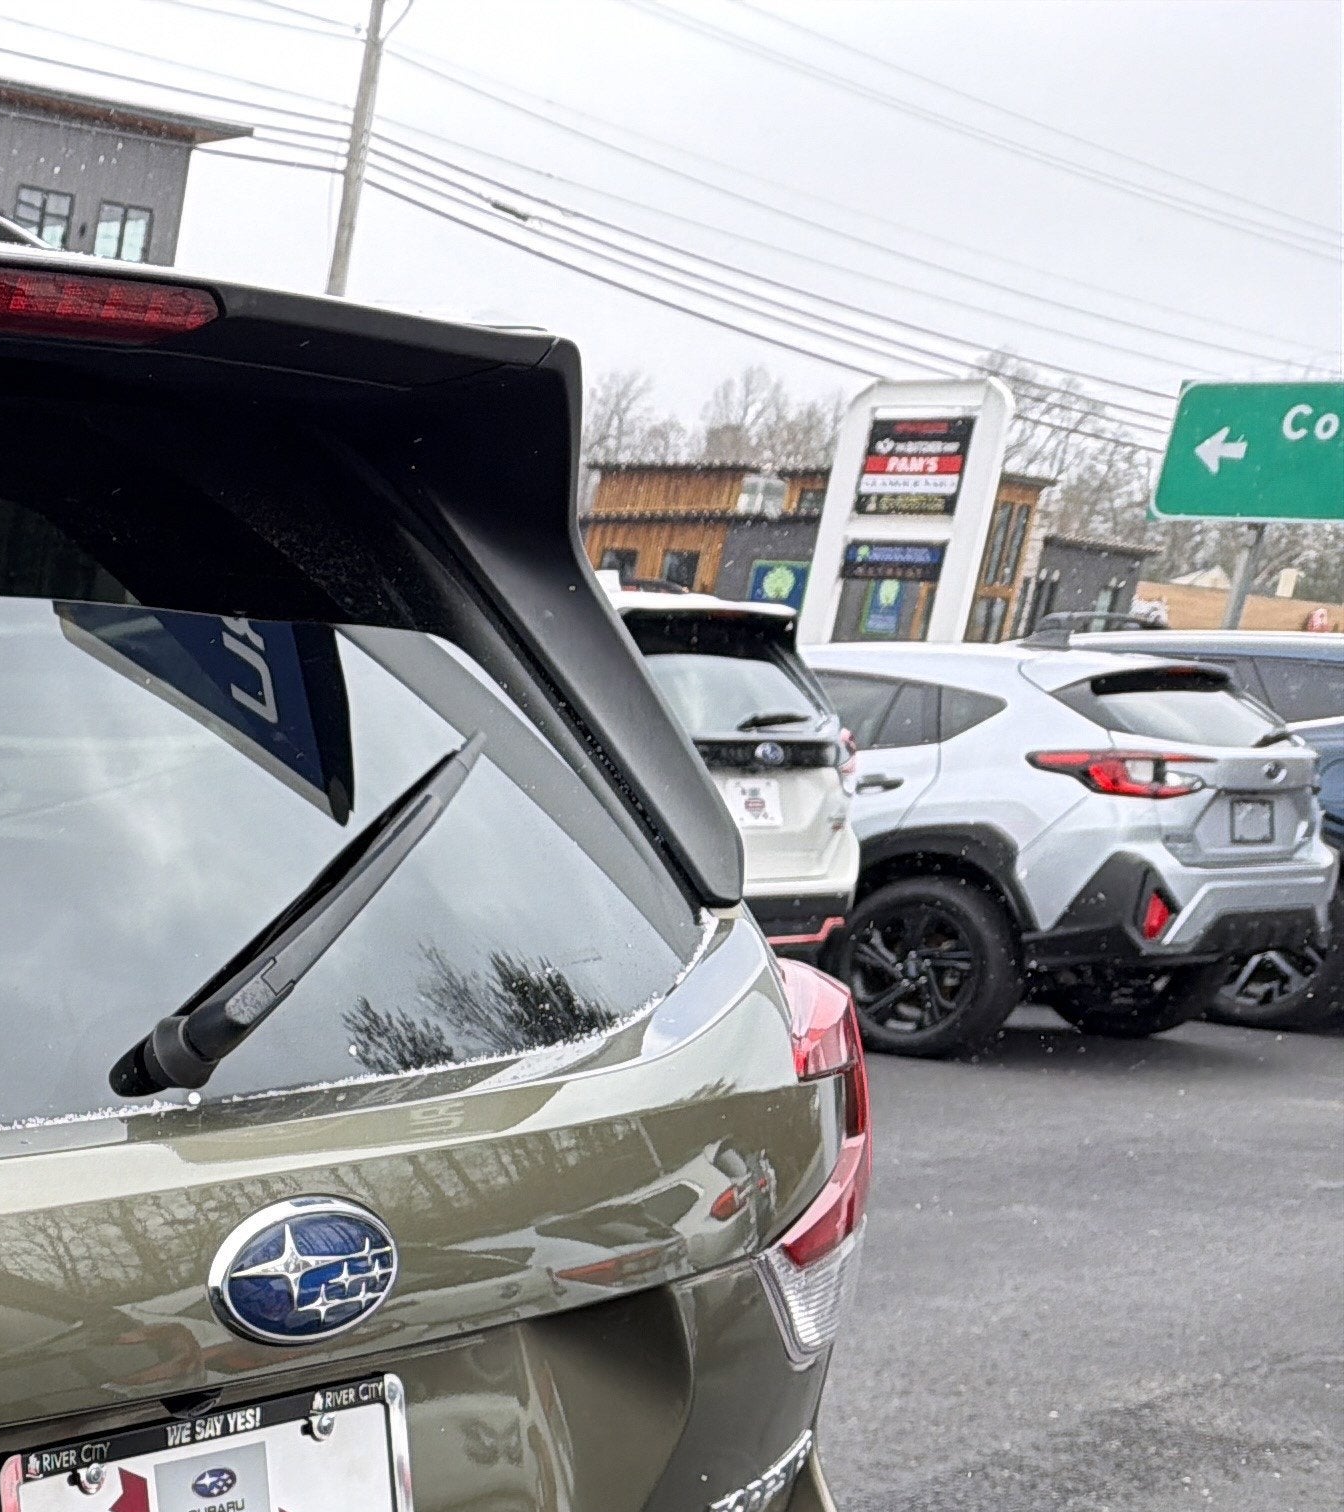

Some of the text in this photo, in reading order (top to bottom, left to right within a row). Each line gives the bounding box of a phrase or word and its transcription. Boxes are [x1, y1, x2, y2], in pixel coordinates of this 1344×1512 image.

[325, 1381, 385, 1408] RIVER CITY
[166, 1407, 262, 1447] WE SAY YES!
[42, 1441, 112, 1472] RIVER CITY
